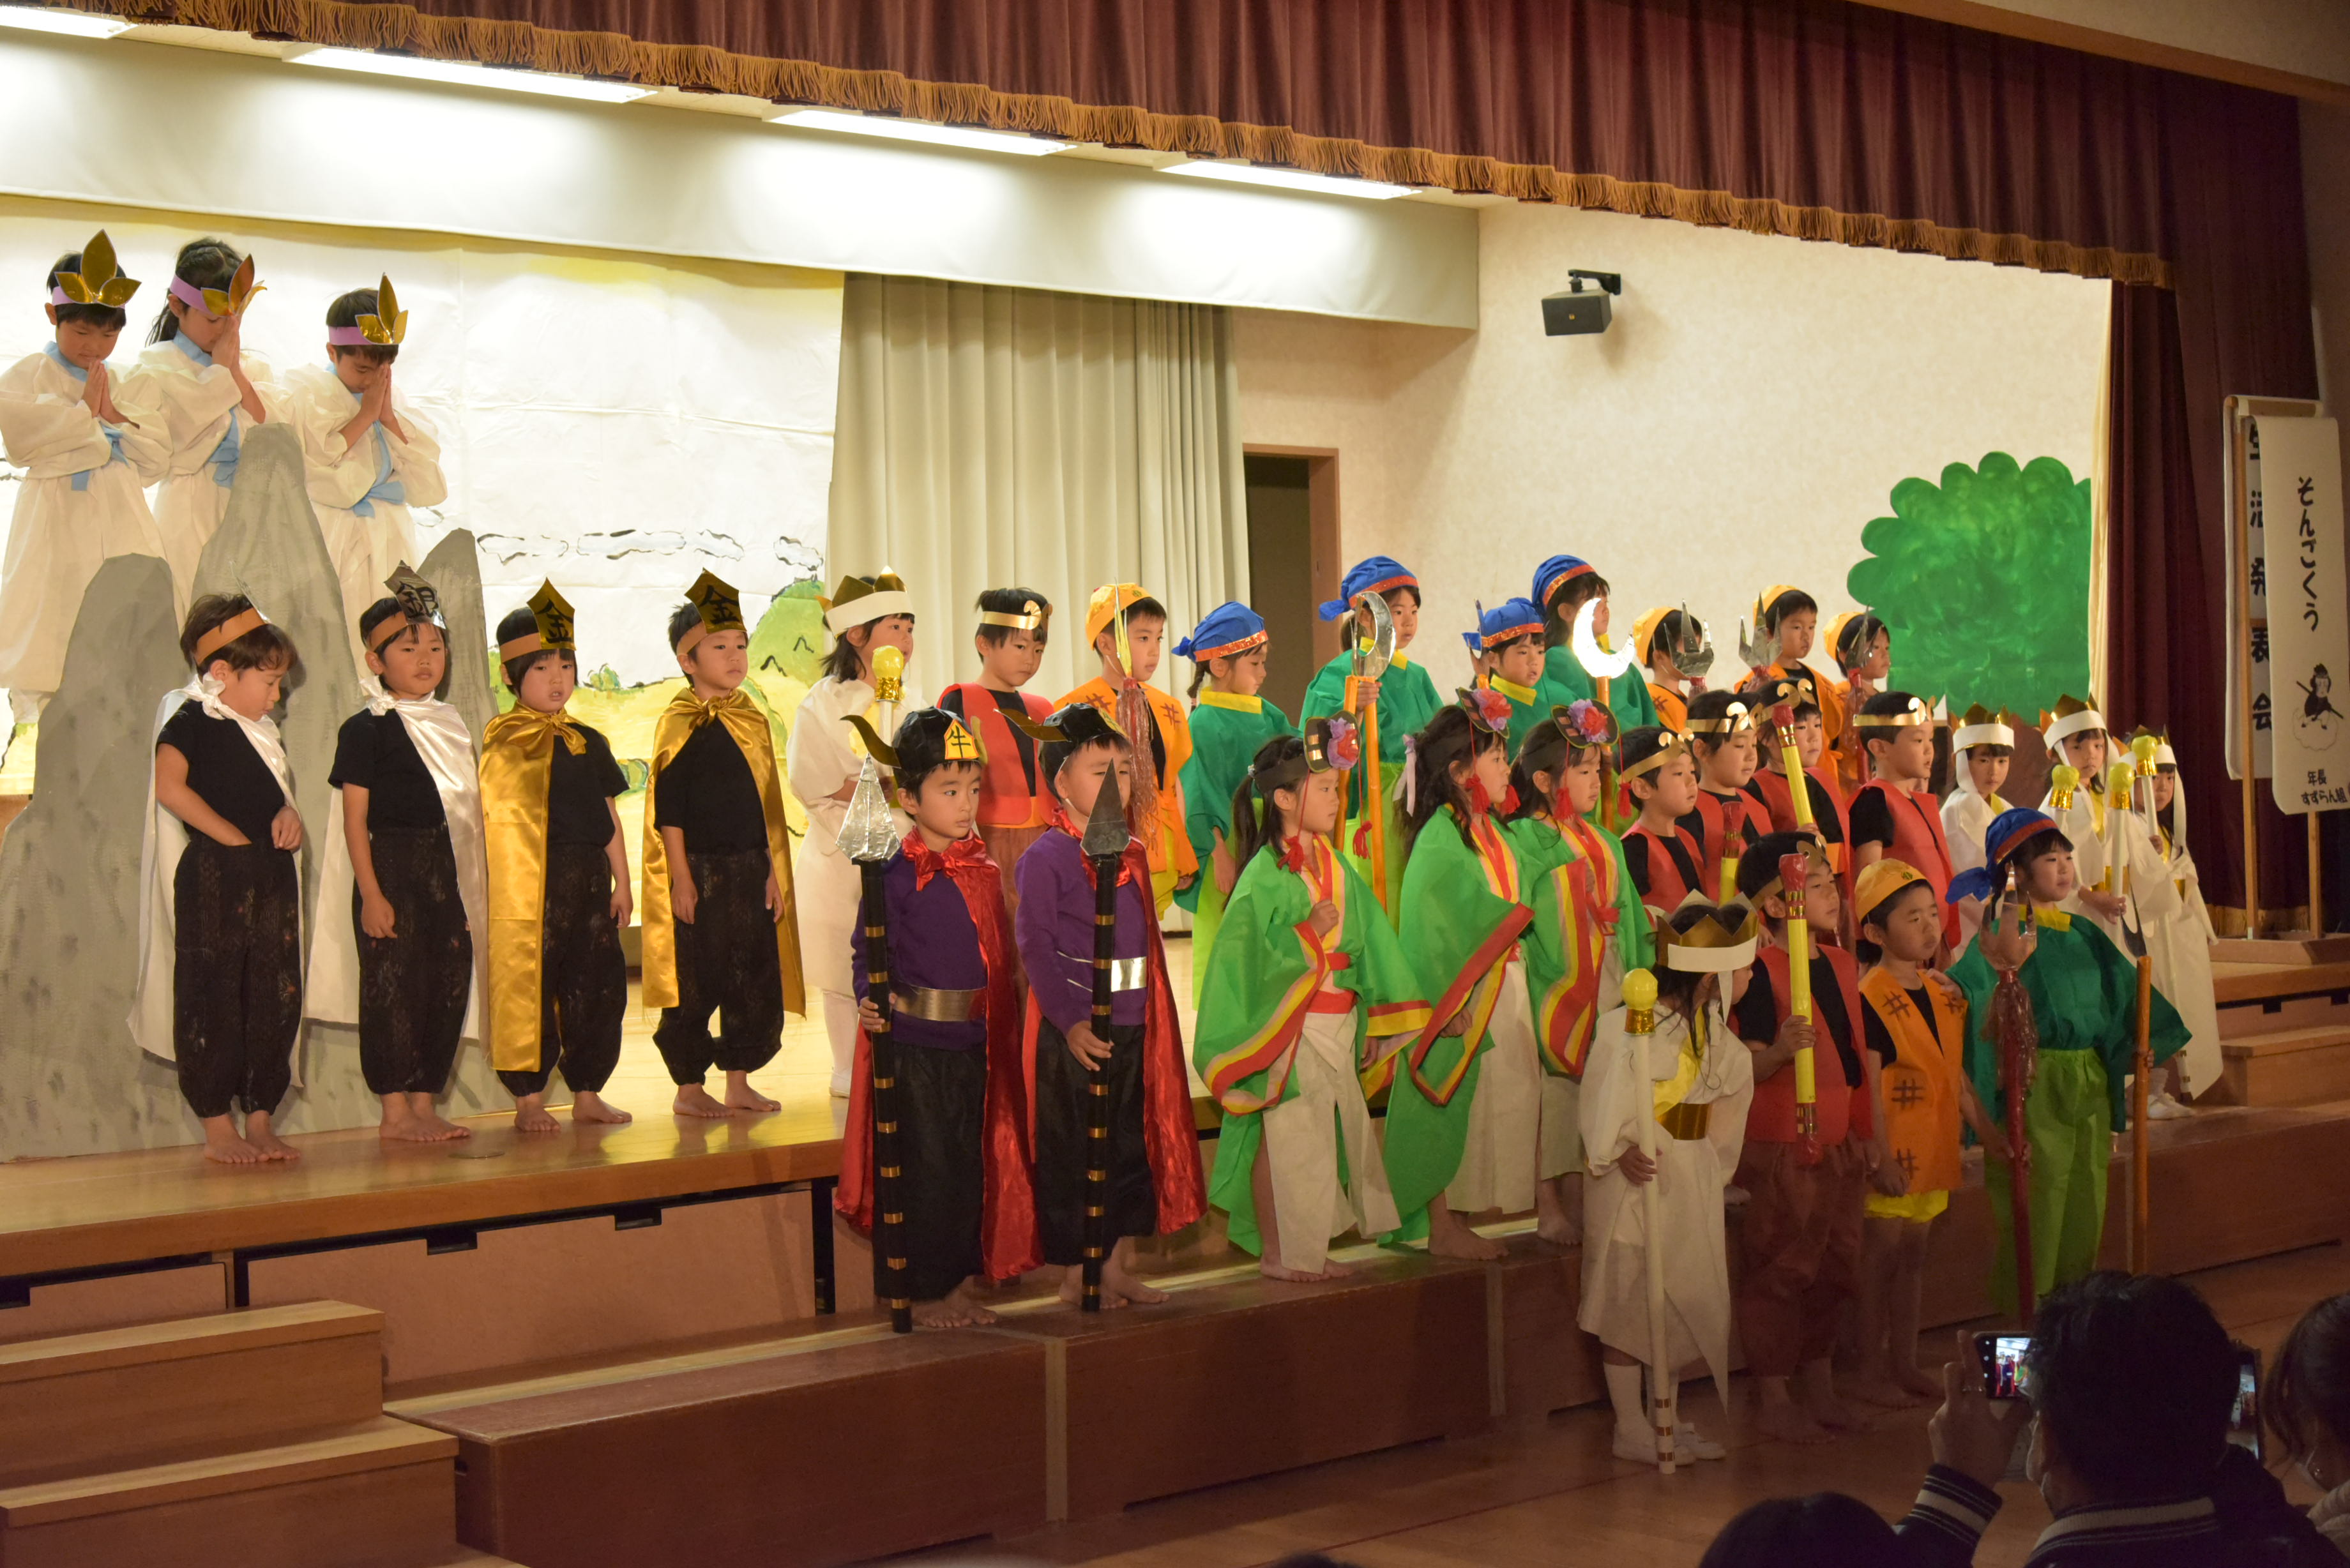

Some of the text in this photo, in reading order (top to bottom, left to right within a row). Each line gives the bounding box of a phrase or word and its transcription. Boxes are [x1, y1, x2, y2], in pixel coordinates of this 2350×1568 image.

[2297, 476, 2319, 632] そんごくう
[396, 581, 441, 621] 銀
[534, 598, 574, 644] 金
[699, 585, 739, 625] 金
[947, 725, 971, 758] 牛
[2301, 787, 2348, 806] すずらん組
[2307, 769, 2327, 787] 年長
